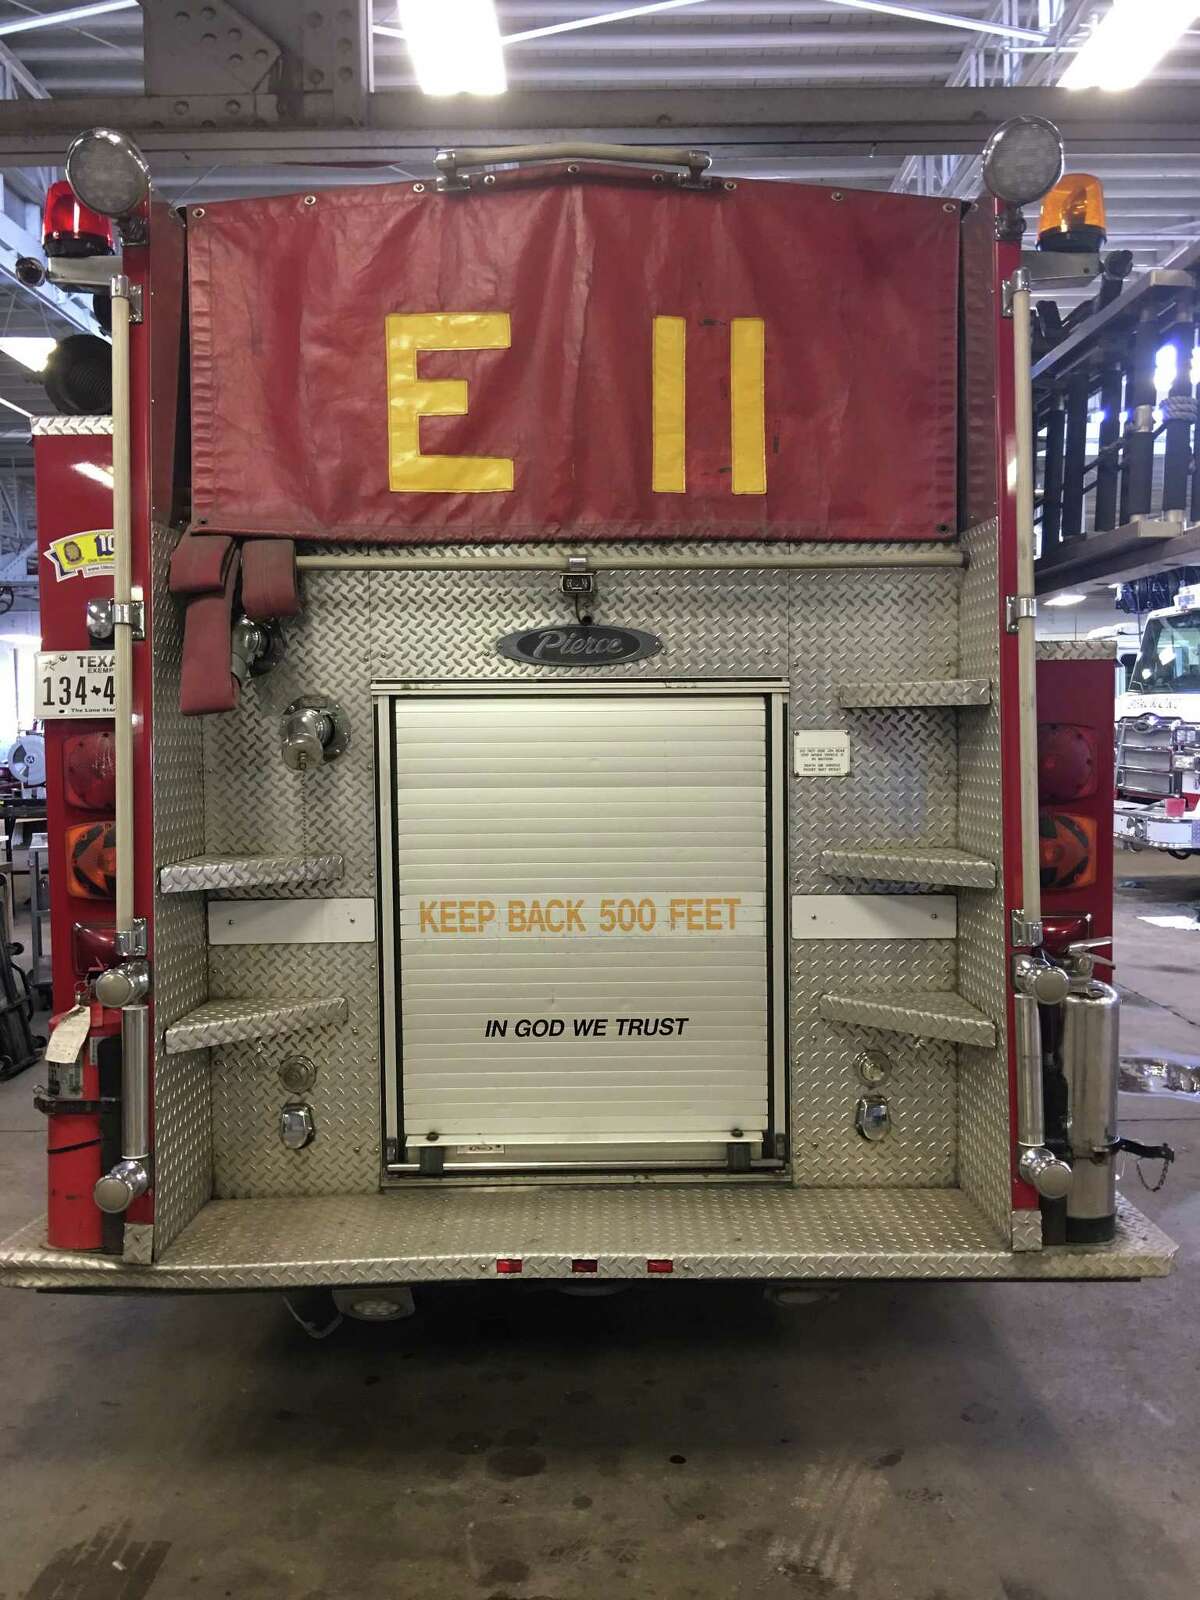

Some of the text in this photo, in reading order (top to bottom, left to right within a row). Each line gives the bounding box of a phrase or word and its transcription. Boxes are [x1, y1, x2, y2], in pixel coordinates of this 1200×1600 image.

[385, 312, 514, 493] E
[533, 630, 623, 659] Pierce
[77, 656, 115, 667] TEXA
[419, 898, 741, 933] KEEP BACK 500 FEET
[485, 1017, 689, 1037] IN GOD WE TRUST
